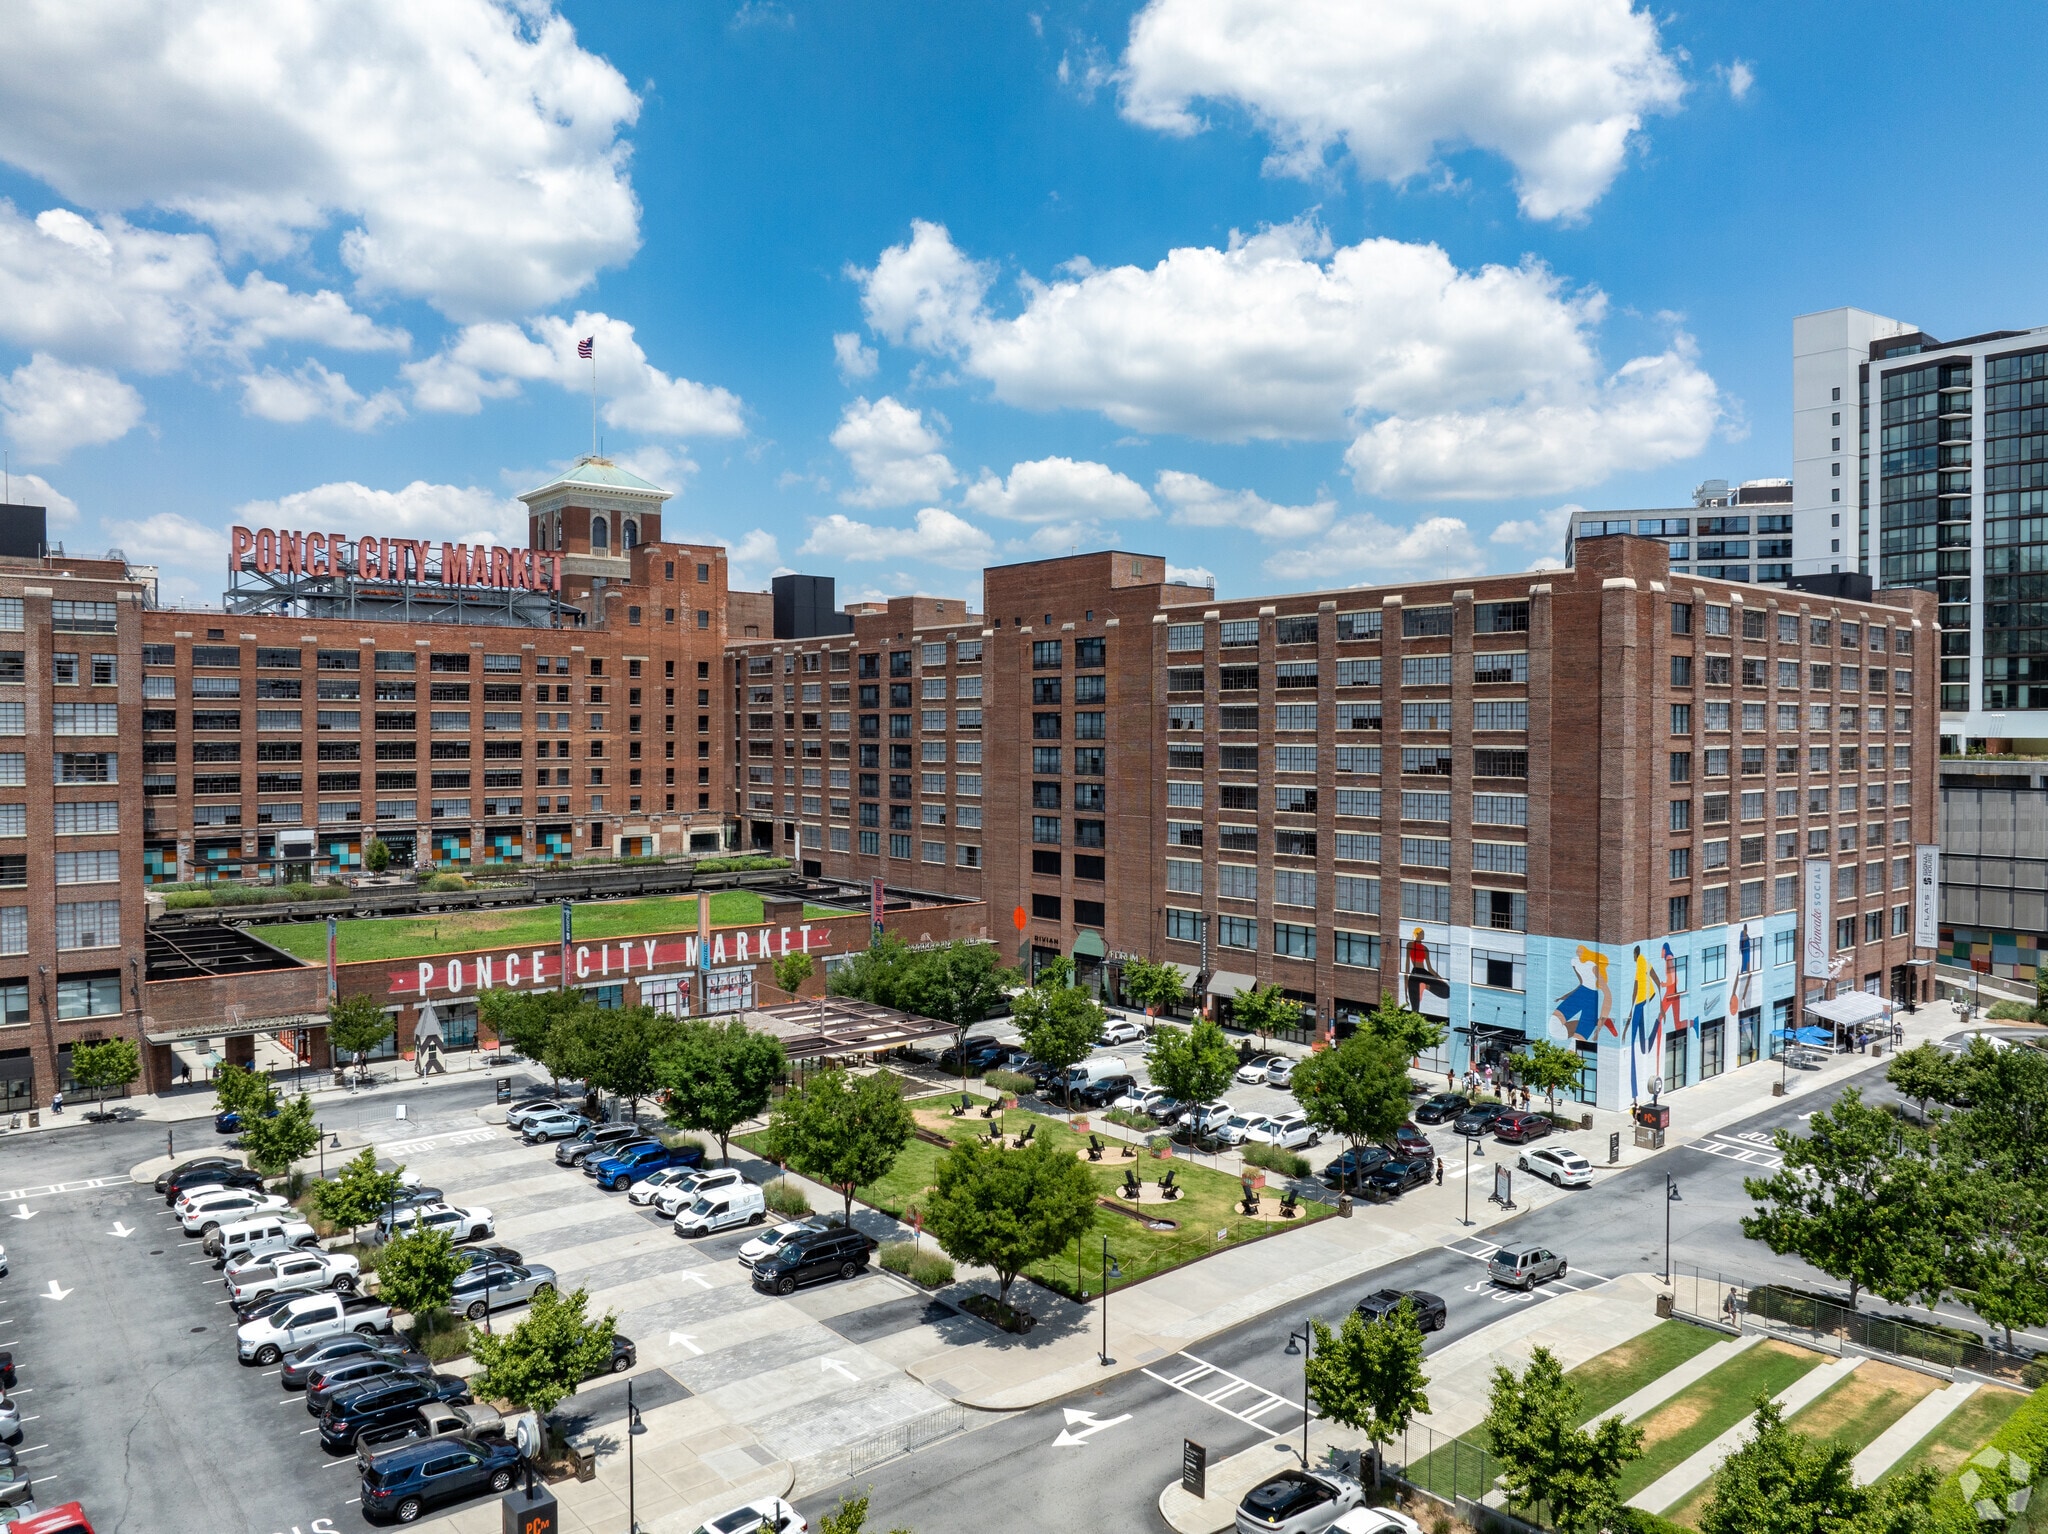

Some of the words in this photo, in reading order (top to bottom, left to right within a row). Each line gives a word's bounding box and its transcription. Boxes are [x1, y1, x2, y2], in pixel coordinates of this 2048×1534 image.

[232, 525, 347, 578] PONCE
[358, 535, 431, 583] CITY
[441, 541, 566, 591] MARKET
[1814, 867, 1822, 906] SOCIAL
[1034, 935, 1059, 945] RIVIAN
[1807, 908, 1825, 958] Pancake
[418, 950, 545, 996] PONCE
[576, 939, 657, 978] CITY
[685, 925, 812, 967] MARKET
[1109, 950, 1139, 963] FORUM
[388, 1140, 437, 1157] STOP
[449, 1130, 498, 1146] STOP
[1737, 1131, 1778, 1146] TOP
[1464, 1280, 1535, 1304] STOP
[526, 1517, 550, 1534] PCM
